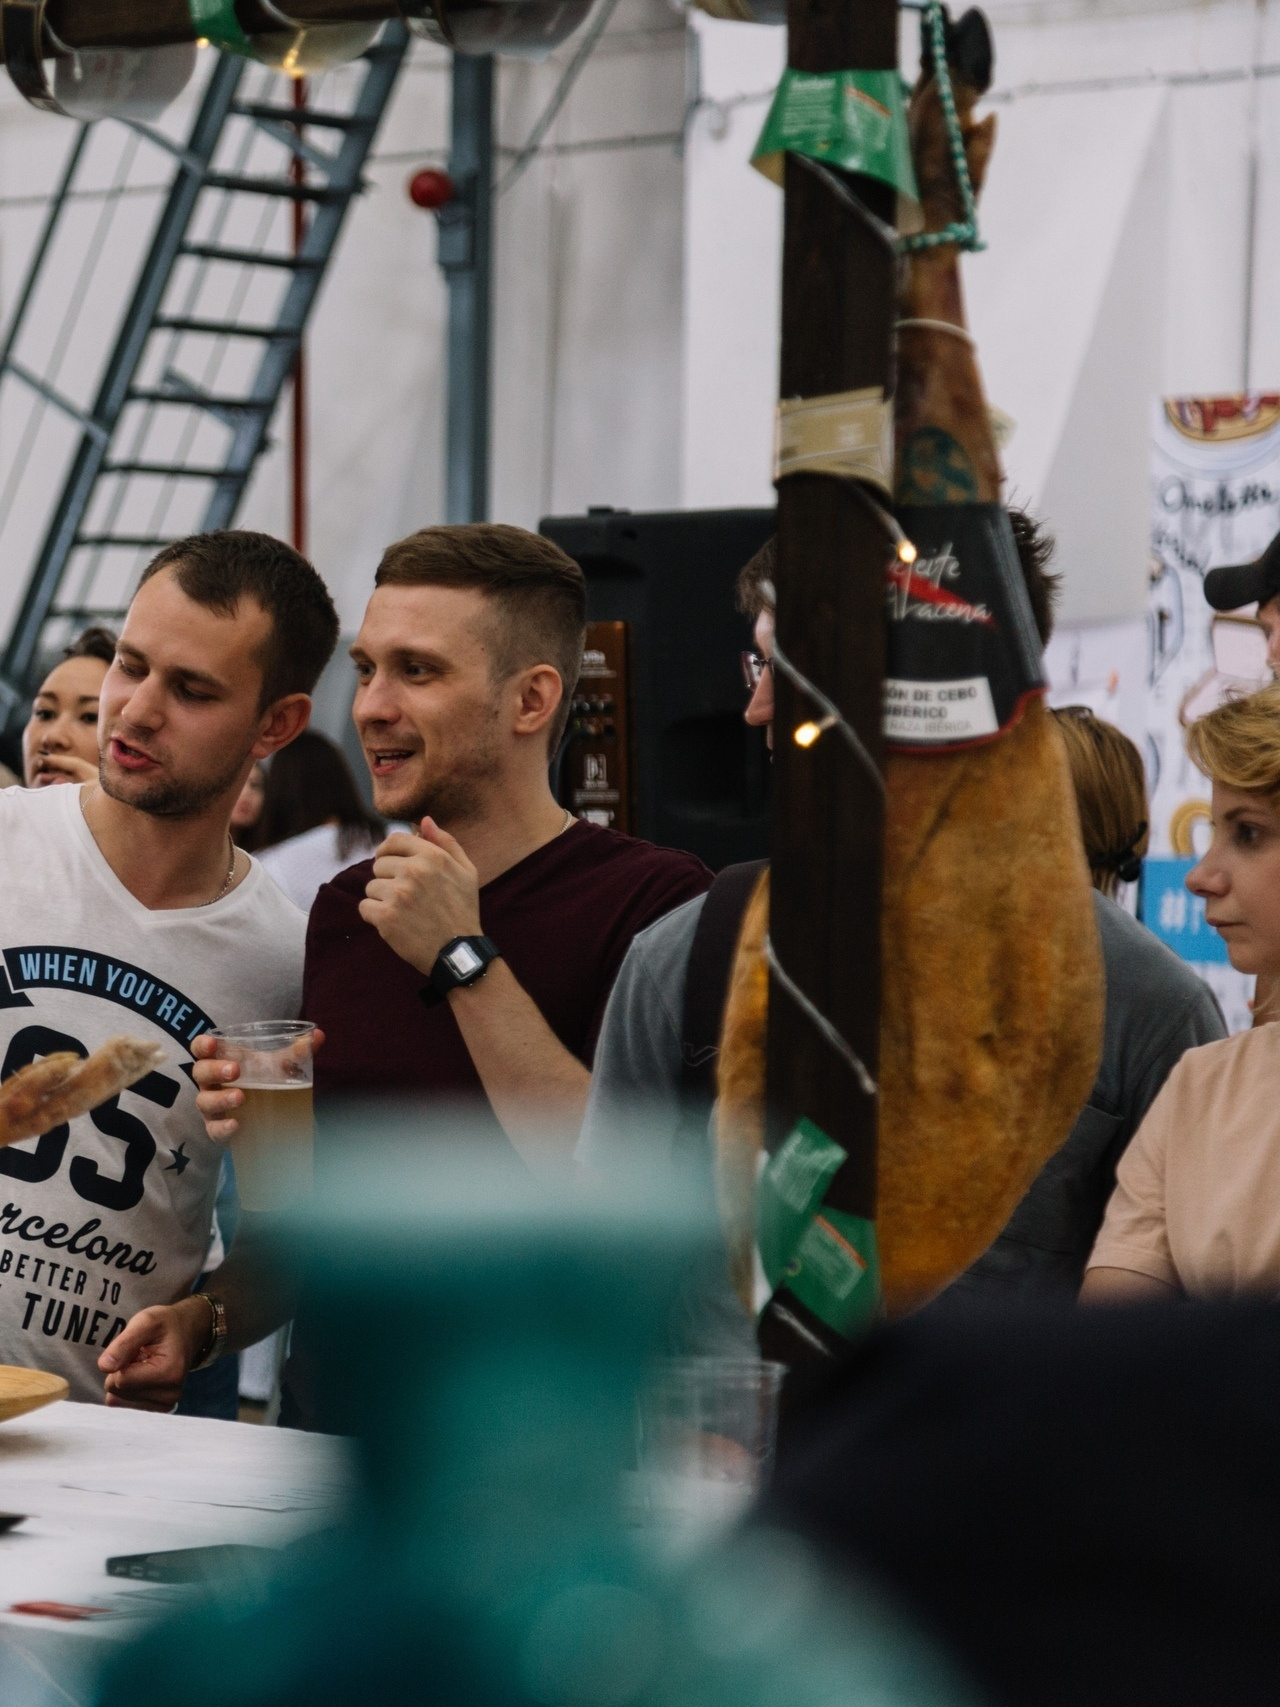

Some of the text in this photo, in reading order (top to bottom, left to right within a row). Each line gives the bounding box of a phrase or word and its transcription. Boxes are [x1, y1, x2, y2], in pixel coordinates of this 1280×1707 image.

[19, 952, 213, 1041] WHEN YOU'RE I
[99, 1277, 122, 1306] TO
